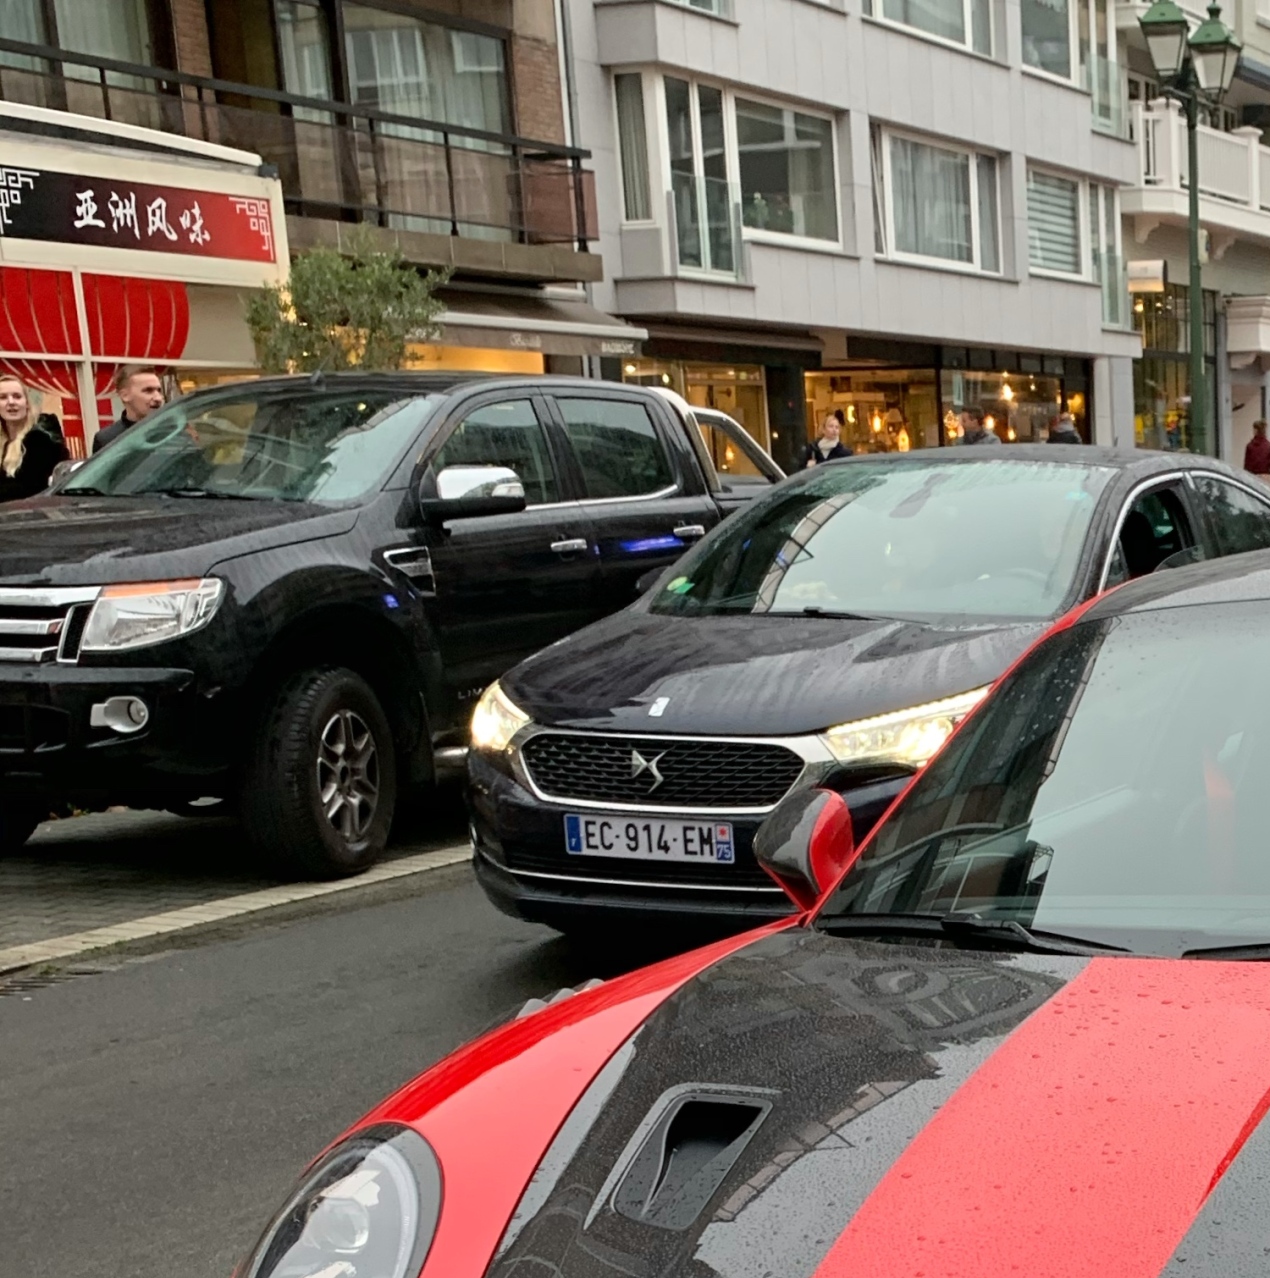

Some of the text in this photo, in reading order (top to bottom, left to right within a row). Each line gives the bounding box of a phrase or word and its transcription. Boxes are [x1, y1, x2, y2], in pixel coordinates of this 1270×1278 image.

[74, 190, 211, 246] 亚洲风味
[716, 843, 732, 859] 75
